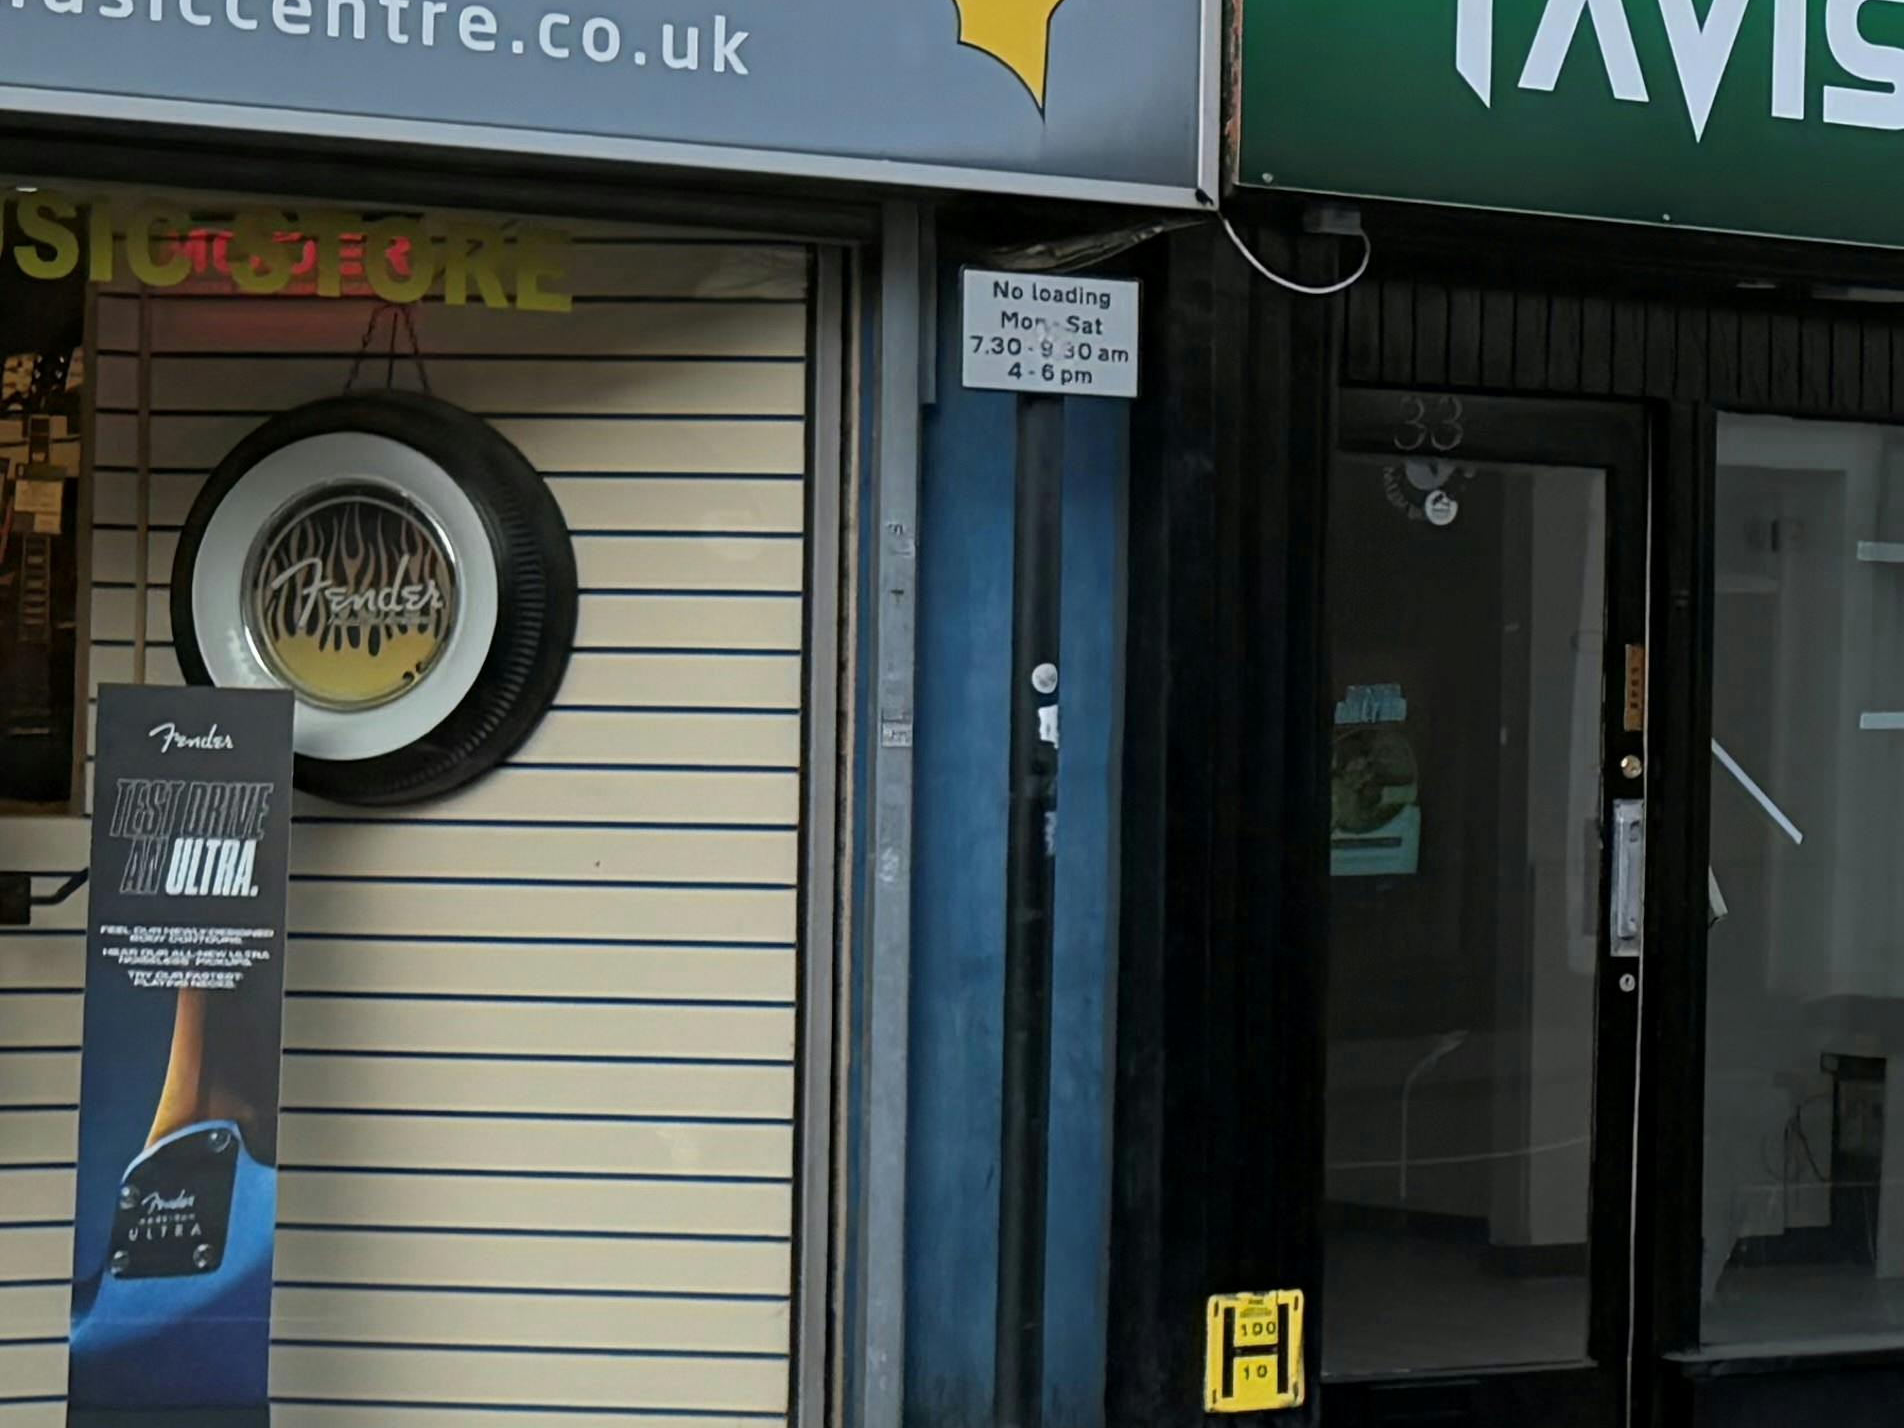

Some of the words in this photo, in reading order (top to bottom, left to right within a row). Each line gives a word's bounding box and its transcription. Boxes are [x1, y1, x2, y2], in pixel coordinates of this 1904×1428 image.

[0, 186, 193, 288] SIC
[229, 206, 573, 313] STORE
[992, 280, 1024, 301] No
[1032, 283, 1112, 310] loading
[1066, 314, 1104, 336] Sat
[969, 335, 1022, 356] 7.30
[1097, 347, 1129, 363] am
[1007, 361, 1022, 380] 4
[1041, 363, 1055, 382] 6
[1060, 368, 1093, 386] pm
[1393, 395, 1464, 451] 33
[270, 553, 443, 628] Fender
[148, 722, 234, 754] Fender
[109, 778, 186, 838] TEST
[181, 781, 274, 841] DRIVE
[119, 836, 169, 895] AN
[164, 837, 259, 898] ULTRA.
[1240, 1320, 1276, 1337] 100
[1244, 1365, 1268, 1380] 10
